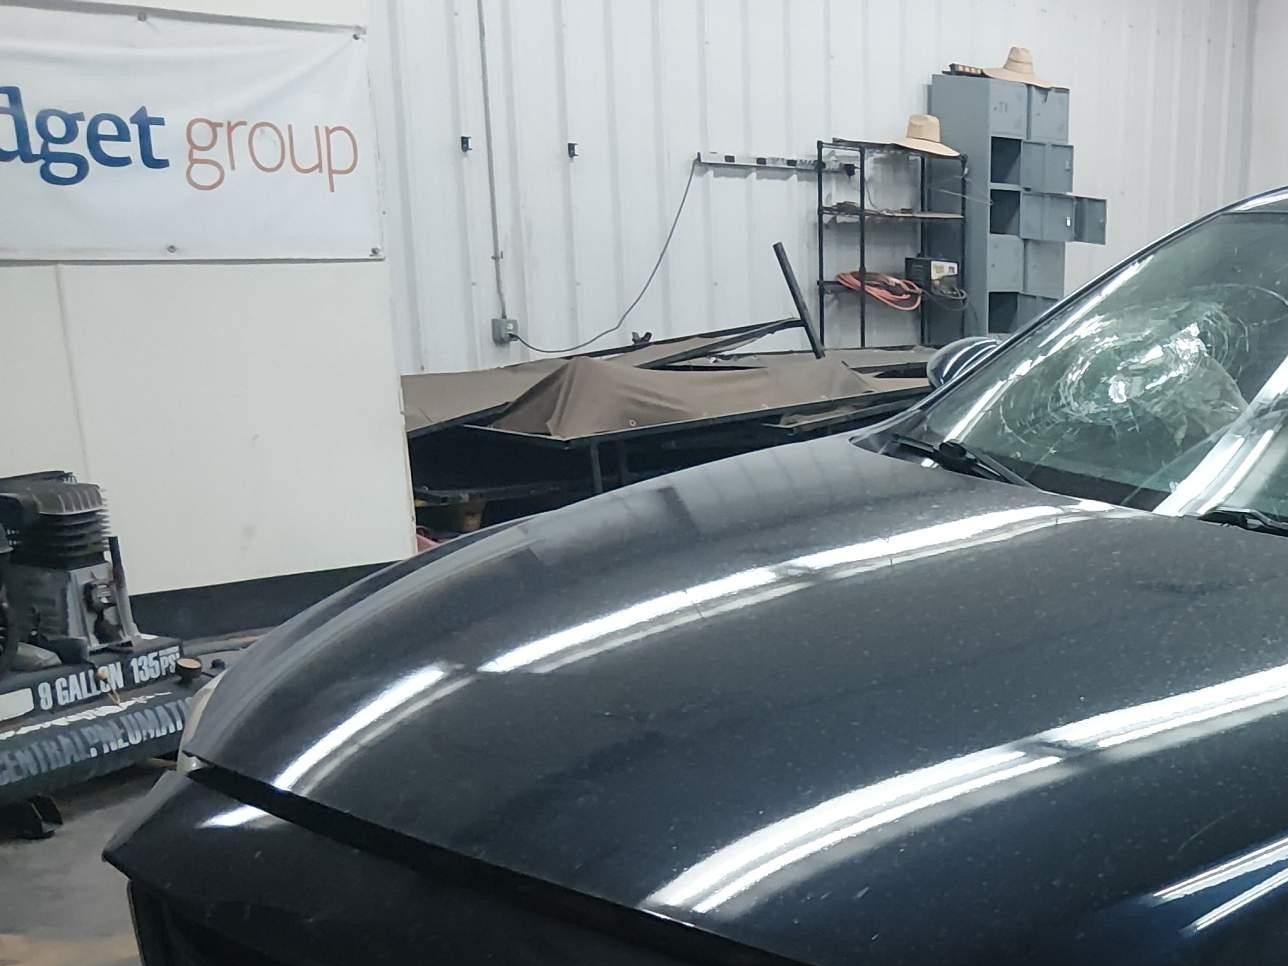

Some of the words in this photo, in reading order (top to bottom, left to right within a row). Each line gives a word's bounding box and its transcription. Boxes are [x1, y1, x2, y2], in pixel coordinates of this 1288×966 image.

[186, 117, 358, 192] group
[37, 682, 53, 711] 8
[55, 662, 124, 706] GALLON
